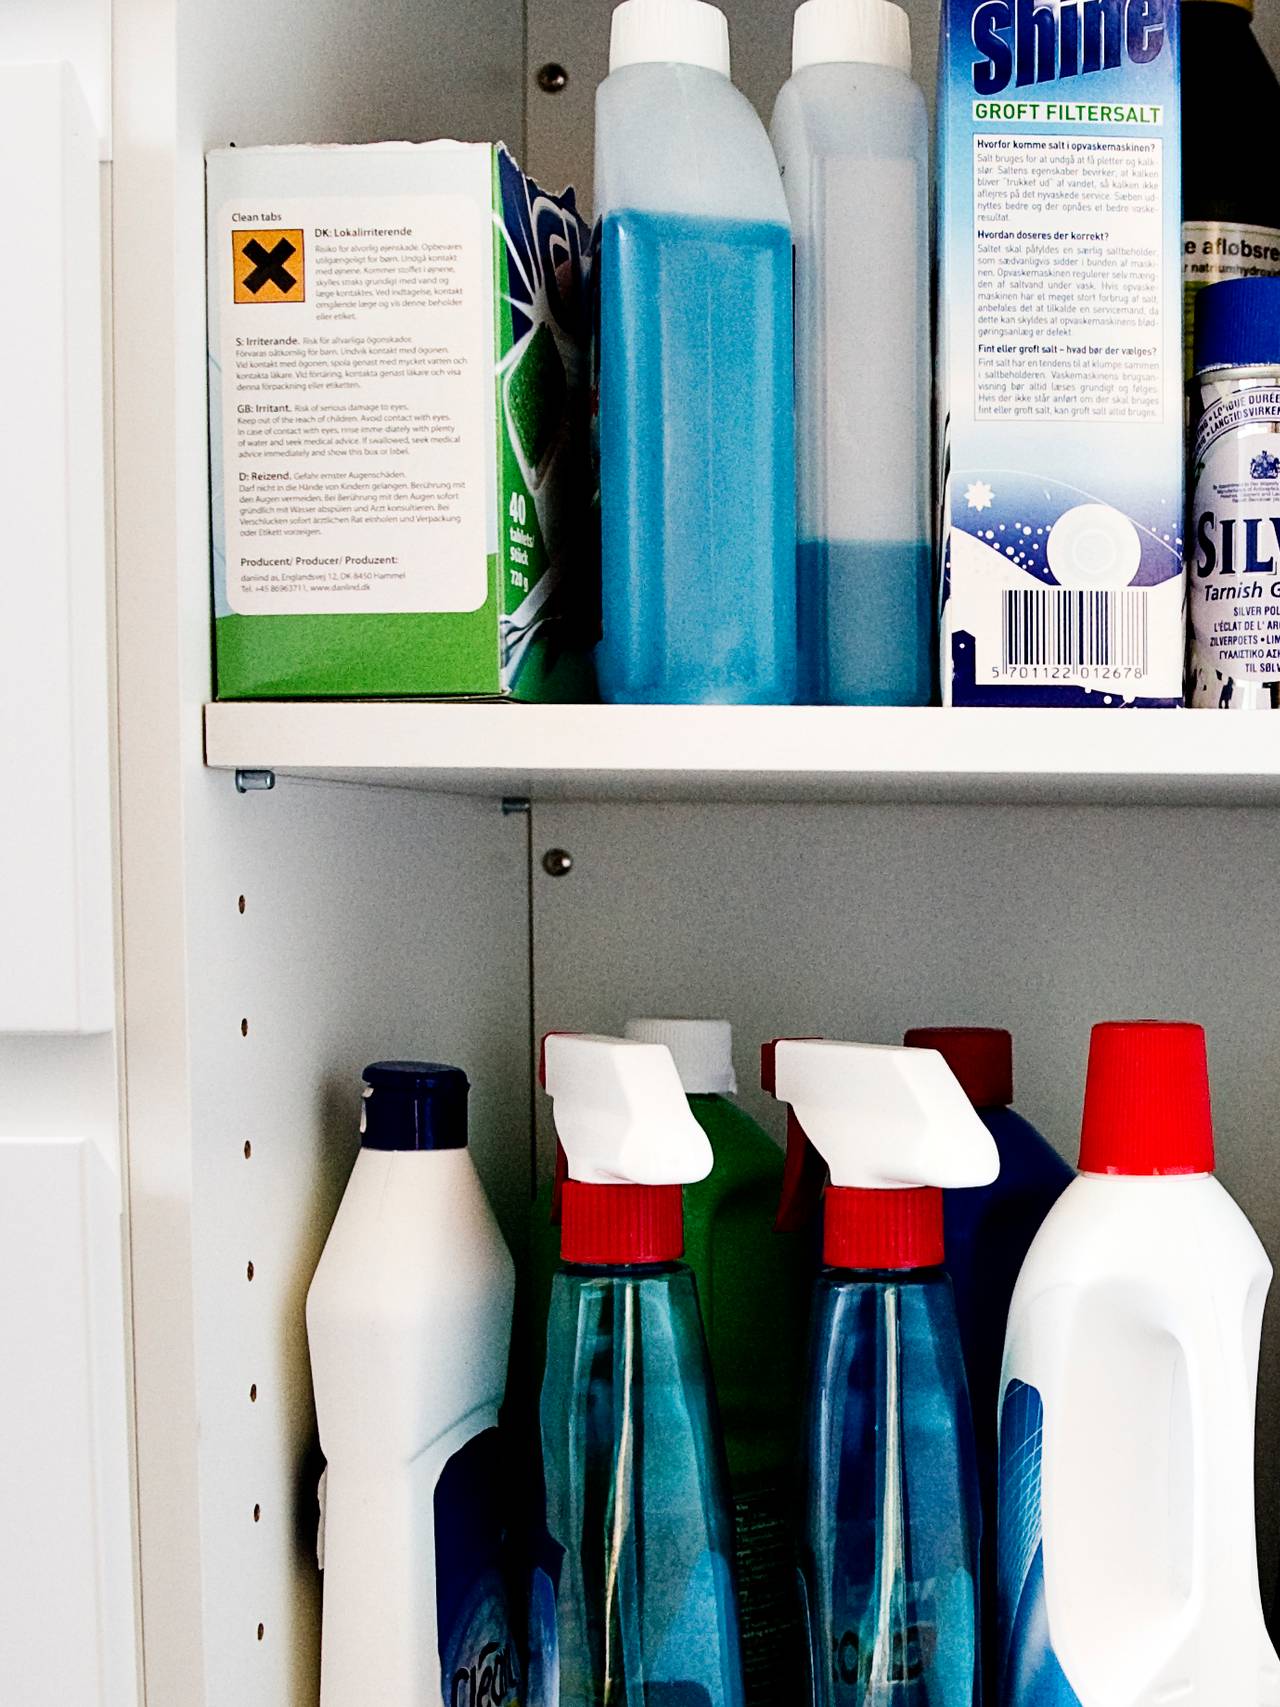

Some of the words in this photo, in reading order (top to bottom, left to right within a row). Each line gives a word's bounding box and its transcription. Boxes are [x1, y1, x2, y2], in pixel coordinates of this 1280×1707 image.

[976, 103, 1039, 119] GROFT
[1047, 105, 1160, 123] FILTERSALT
[977, 139, 1010, 149] Hvorfor
[1013, 140, 1046, 149] komme
[1049, 141, 1064, 149] salt
[1071, 142, 1155, 153] opvaskemaskinen?
[232, 213, 258, 221] Clean
[261, 212, 281, 221] tabs
[315, 228, 331, 237] DK:
[334, 227, 412, 237] Lokalirriterende
[978, 230, 1014, 239] Hvordan
[1016, 231, 1051, 240] doseres
[1054, 232, 1068, 240] der
[1071, 232, 1109, 240] korrekt?
[236, 337, 243, 345] S:
[246, 336, 300, 345] Irriterande.
[978, 344, 994, 352] Fint
[997, 345, 1016, 353] eller
[1019, 345, 1039, 355] groft
[1041, 345, 1057, 353] salt
[1066, 345, 1086, 354] hvad
[1089, 346, 1102, 354] bør
[1105, 346, 1119, 355] der
[1249, 393, 1280, 403] DURÉE
[237, 404, 253, 413] GB:
[256, 404, 291, 412] Irritant.
[239, 472, 249, 480] D:
[251, 472, 291, 480] Reizend.
[510, 491, 526, 525] 40
[240, 558, 292, 567] Producent/
[295, 556, 342, 565] Producer/
[345, 555, 397, 564] Produzent:
[1205, 582, 1262, 601] Tarnish
[1234, 606, 1261, 616] SILVER
[1214, 619, 1242, 632] L'ÉCLAT
[1245, 621, 1254, 630] DE
[1257, 621, 1265, 630] L'
[1210, 635, 1258, 647] ZILVERPOETS
[992, 666, 999, 678] 5
[1008, 666, 1071, 679] 701122
[1080, 667, 1142, 680] 012678
[1245, 664, 1256, 672] TIL
